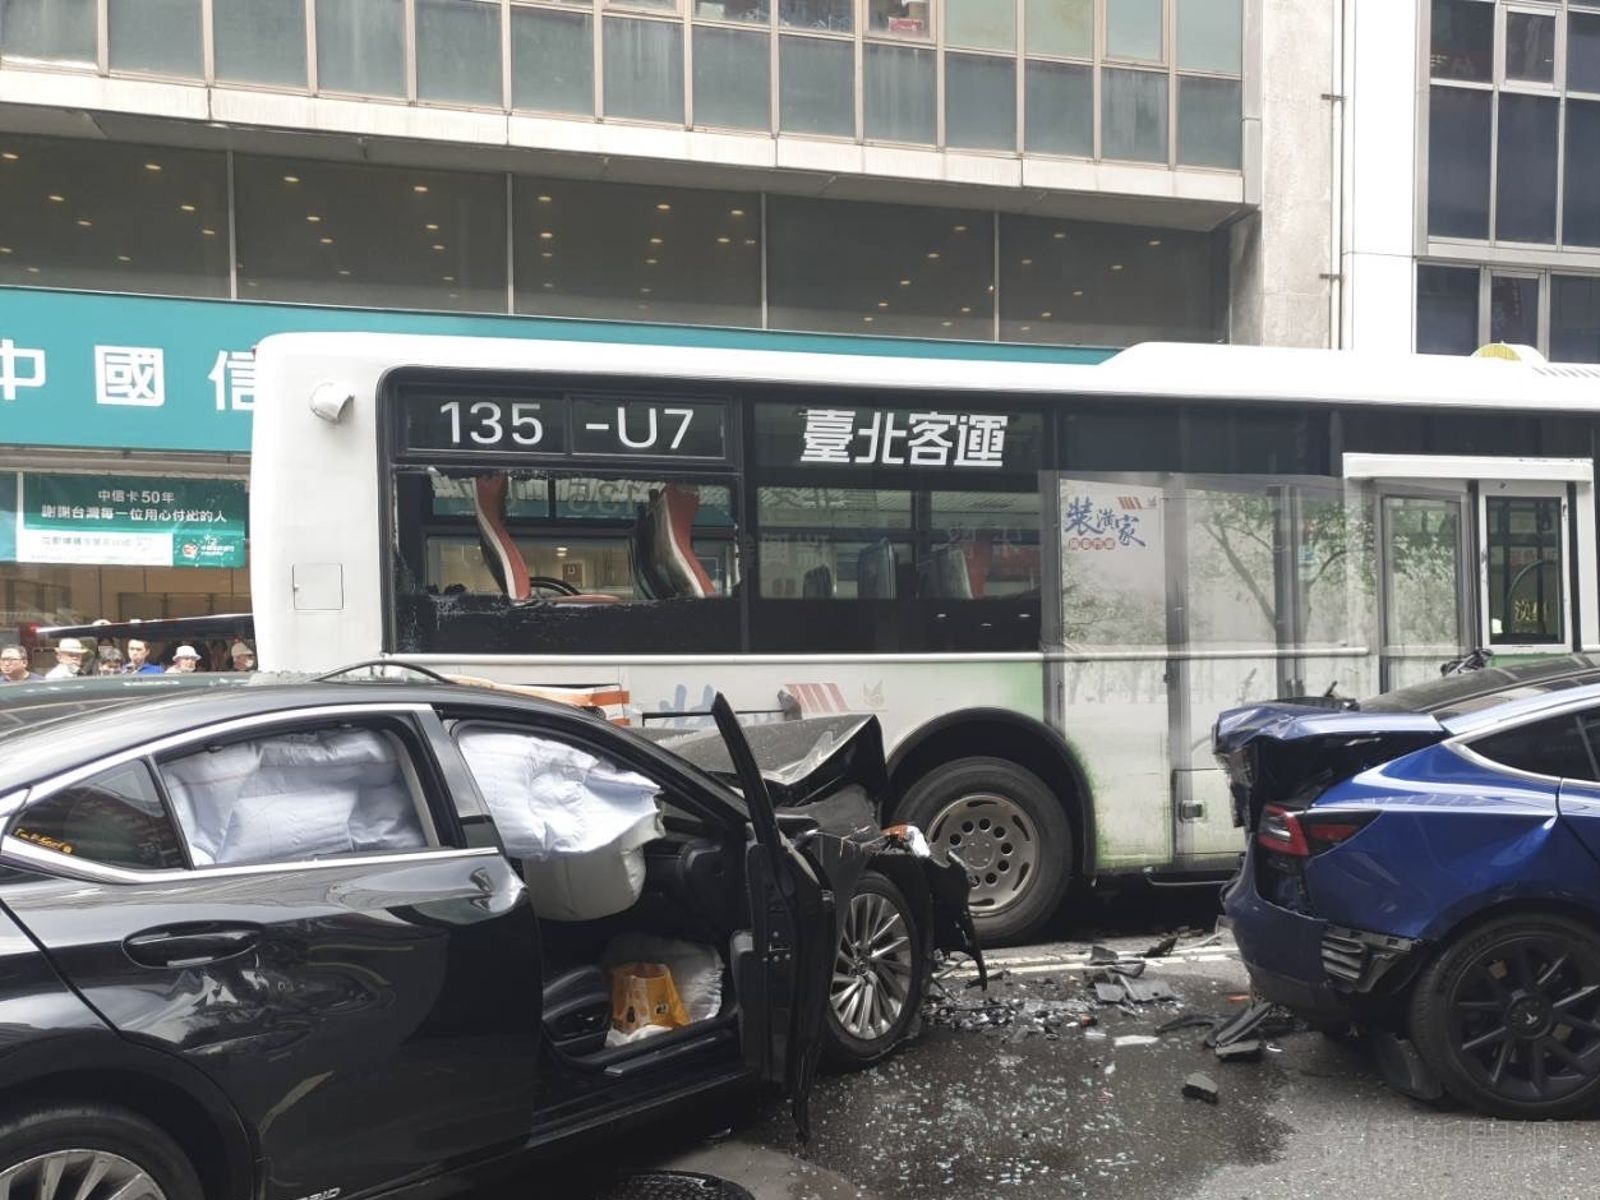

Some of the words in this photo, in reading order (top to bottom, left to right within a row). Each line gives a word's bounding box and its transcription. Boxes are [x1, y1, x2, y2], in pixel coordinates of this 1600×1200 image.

[0, 339, 255, 411] 中國信
[440, 401, 544, 446] 135
[585, 406, 695, 450] -U7
[800, 409, 1008, 468] 臺北客運
[41, 504, 228, 524] 謝謝台灣每一位用心付出的人
[98, 489, 175, 505] 中信卡50年
